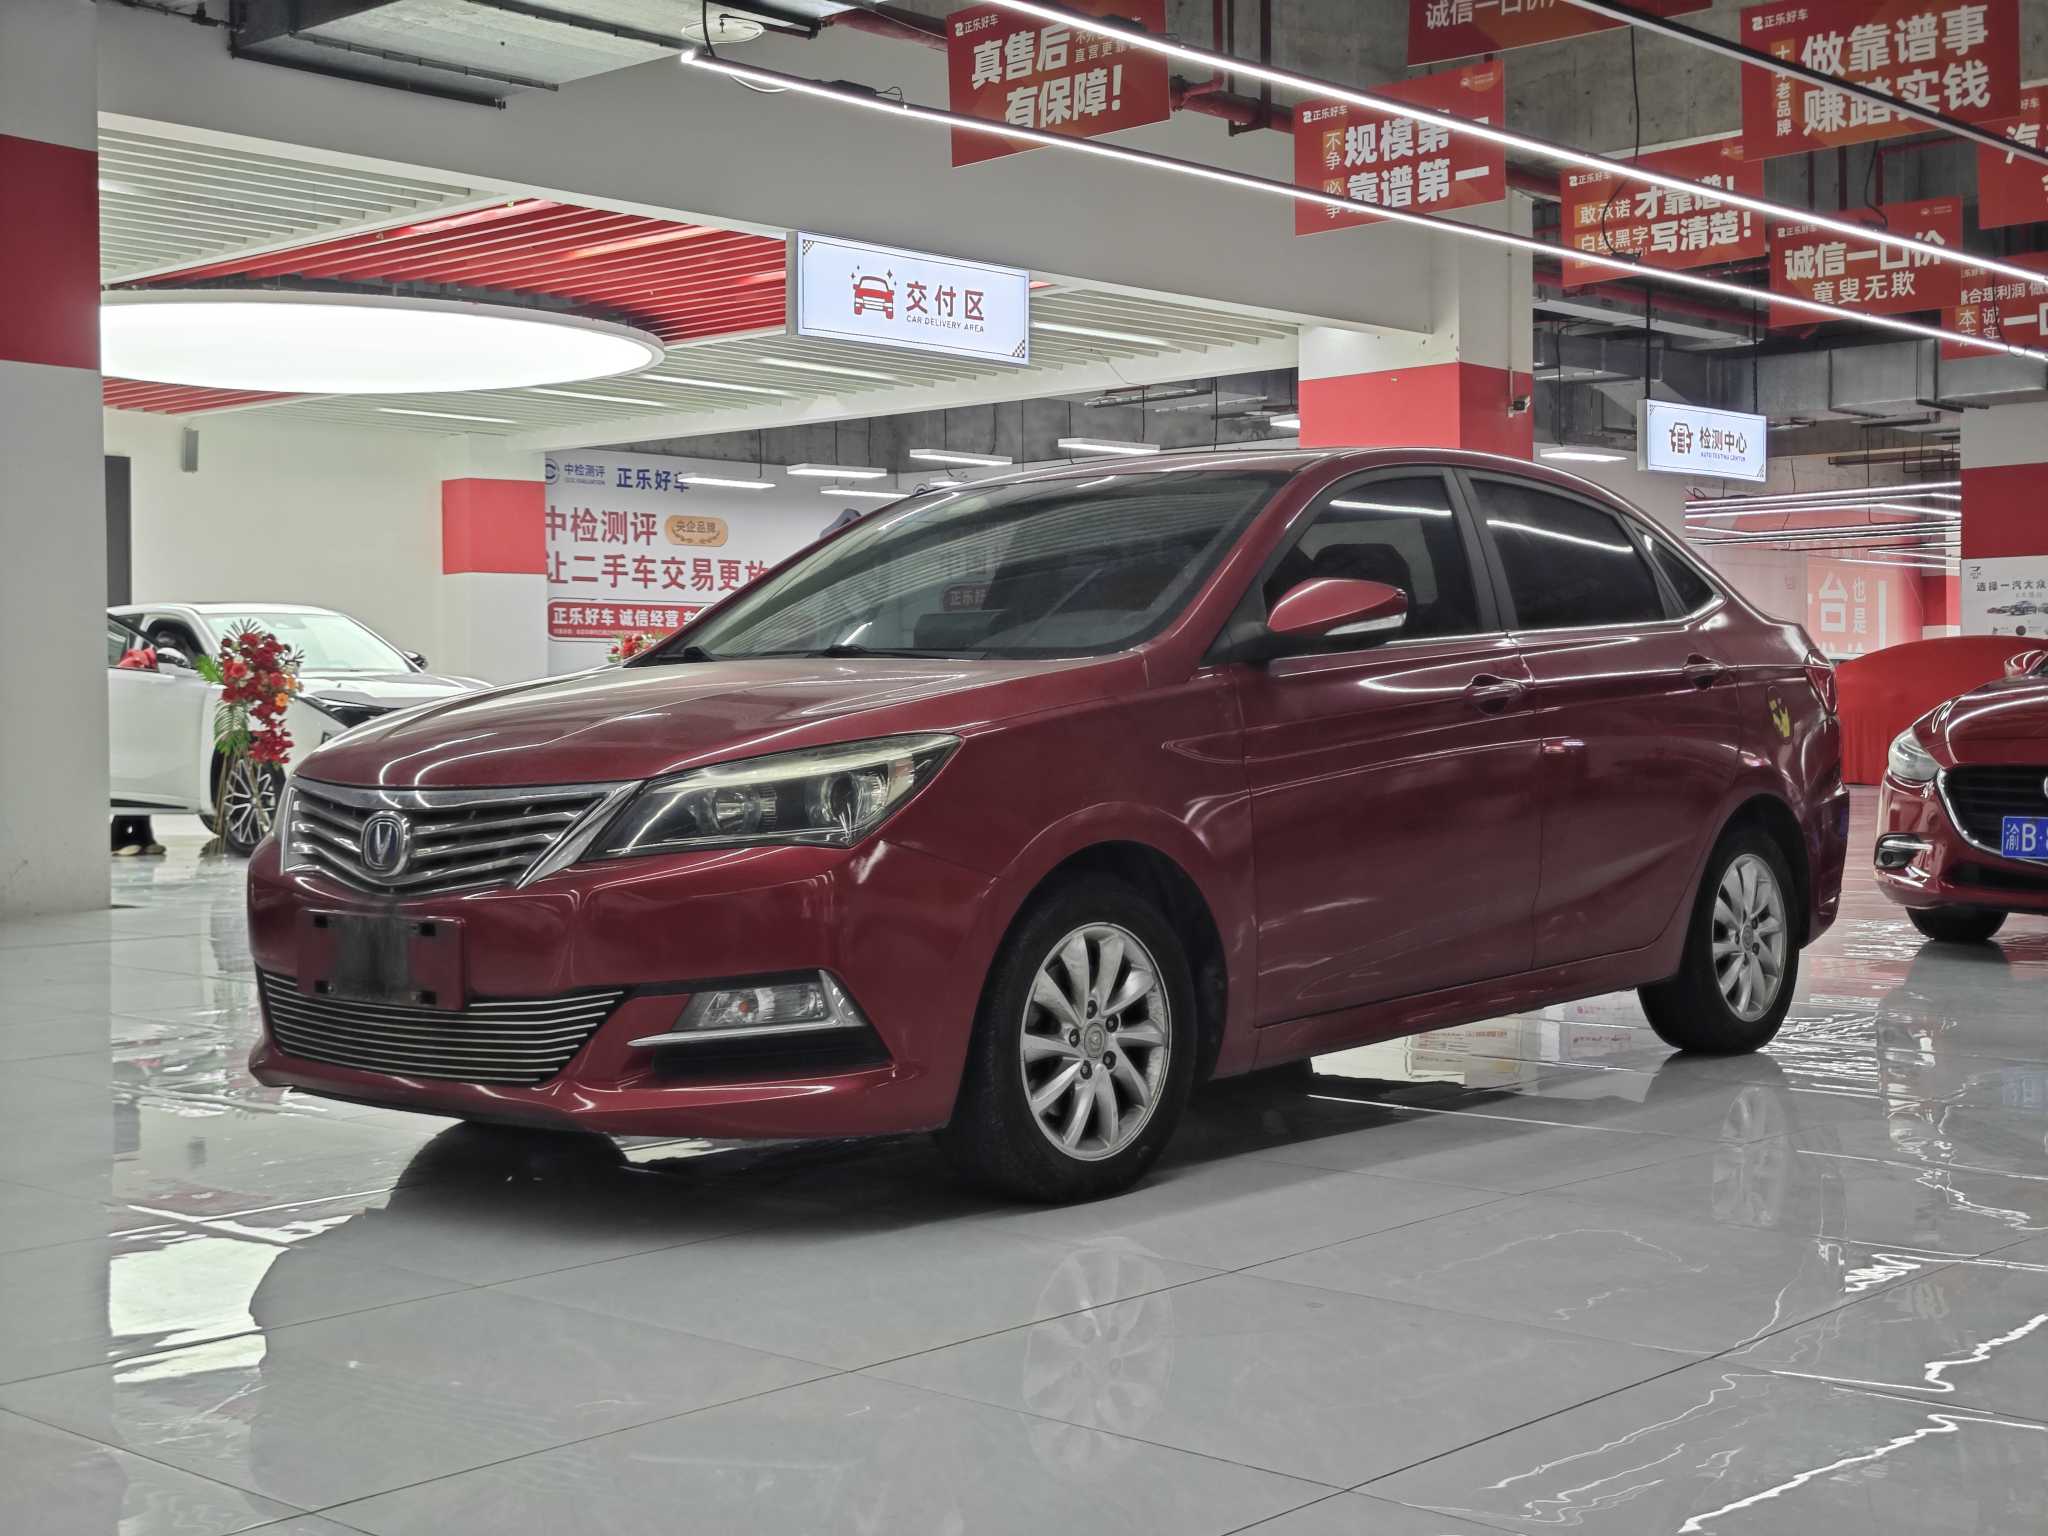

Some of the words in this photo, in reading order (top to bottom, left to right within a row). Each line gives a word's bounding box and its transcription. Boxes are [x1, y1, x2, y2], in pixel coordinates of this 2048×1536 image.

[964, 14, 999, 33] 正乐好车
[1764, 8, 1808, 27] 正乐好车
[1801, 4, 1989, 77] 做靠谱事
[972, 22, 1071, 90] 真售后
[1312, 105, 1348, 121] 正乐好车
[1580, 198, 1632, 225] 敢承诺
[906, 281, 985, 320] 交付区
[1812, 270, 1916, 305] 童叟无欺
[906, 314, 922, 325] CAR
[924, 317, 961, 330] DELIVERY
[963, 323, 984, 333] AREA
[1699, 426, 1747, 454] 检测中心
[564, 462, 605, 478] 中检测评
[545, 505, 658, 546] 中检测评
[552, 607, 615, 626] 正乐好车
[619, 609, 678, 628] 诚信经营
